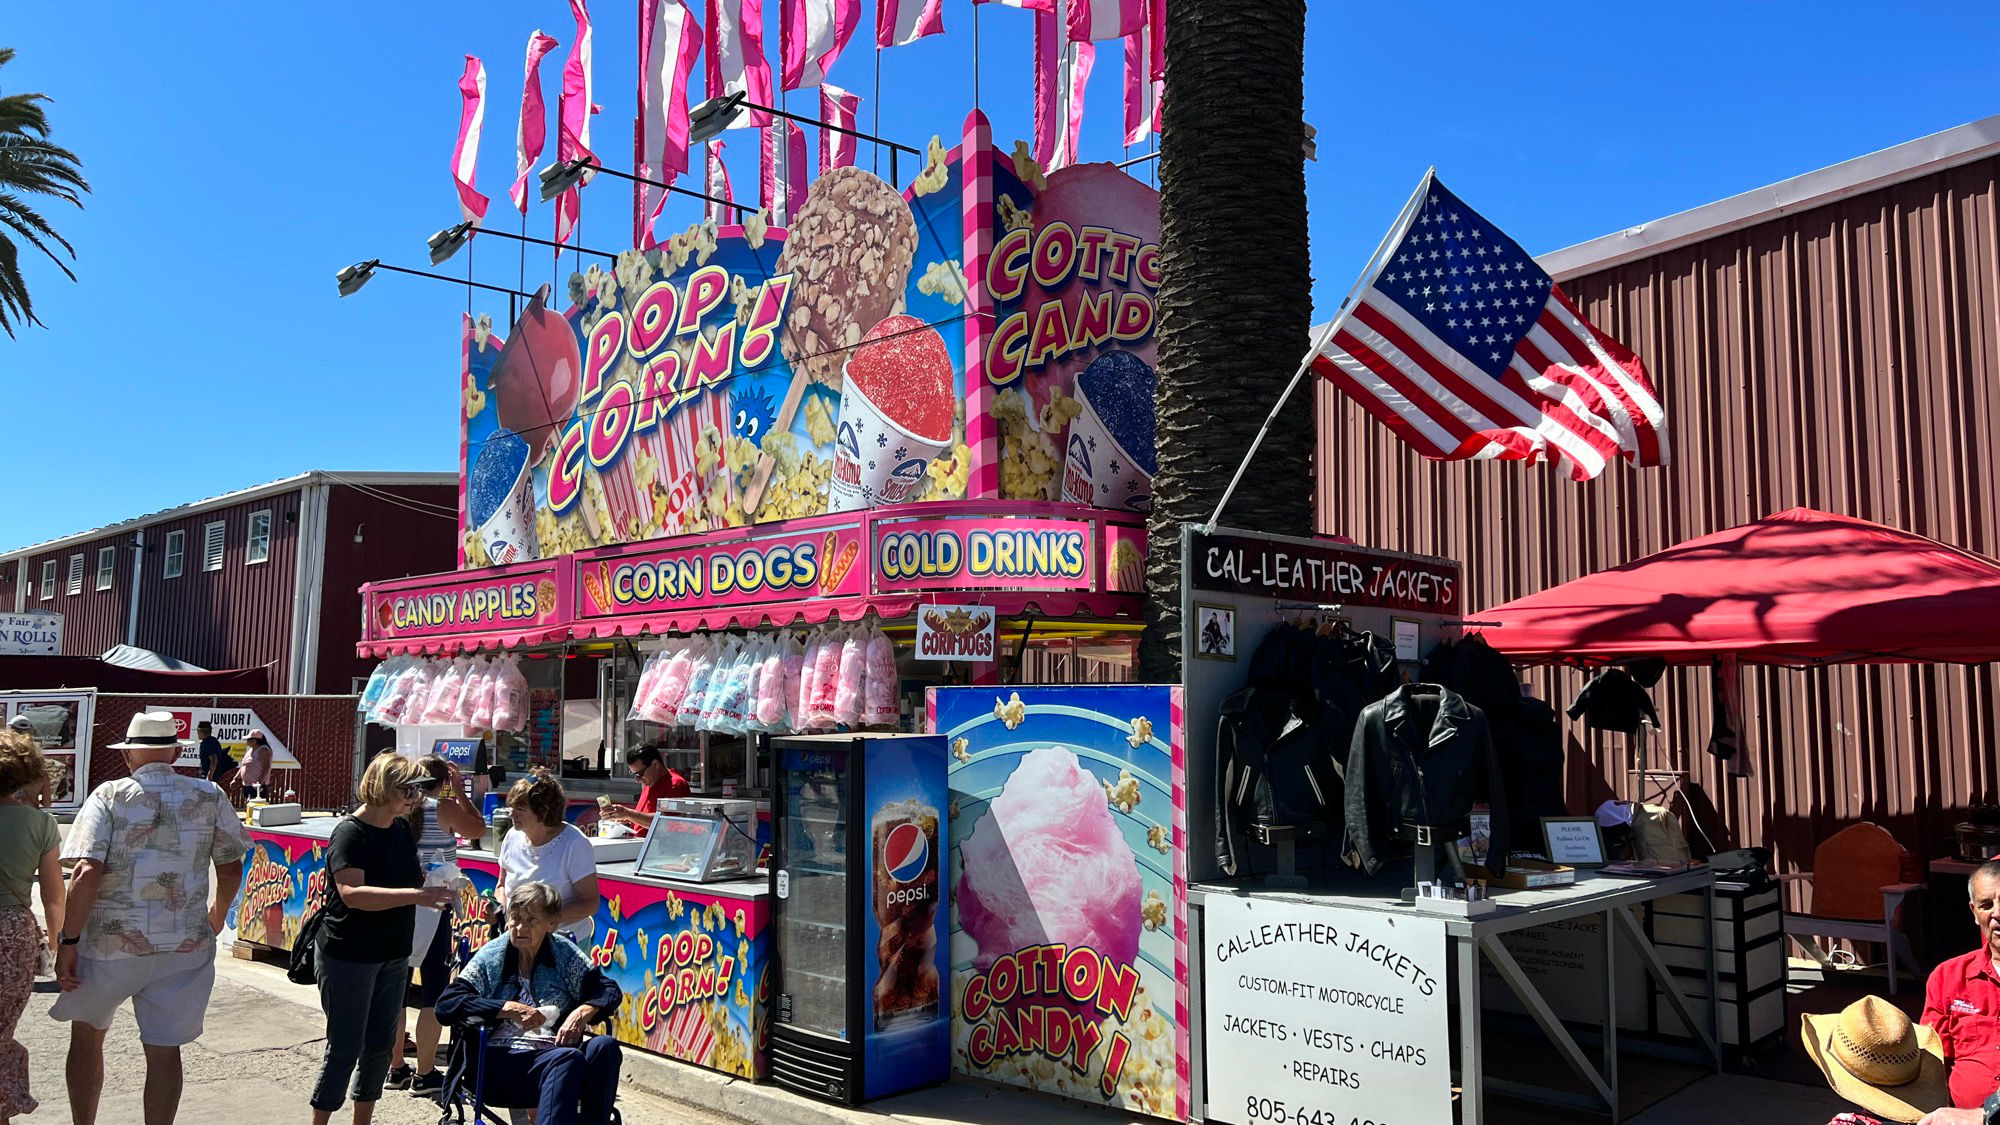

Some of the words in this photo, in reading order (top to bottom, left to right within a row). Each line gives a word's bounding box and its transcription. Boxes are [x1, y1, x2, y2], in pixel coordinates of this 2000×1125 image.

[986, 222, 1161, 301] COTTO
[581, 264, 730, 408] POP
[985, 290, 1159, 385] CAND
[612, 555, 704, 604] CORN
[709, 543, 817, 595] DOGS
[880, 530, 962, 581] COLD
[967, 529, 1086, 580] DRINKS
[1206, 547, 1365, 593] CAL-LEATHER
[1369, 566, 1453, 604] JACKETS
[9, 617, 31, 626] Fair
[393, 592, 458, 629] CANDY
[459, 583, 536, 624] APPLES
[13, 630, 57, 645] ROLLS
[921, 631, 956, 656] CORN
[958, 631, 992, 656] DOGS
[210, 713, 245, 725] JUNIOR
[449, 745, 471, 758] pepsi
[810, 755, 831, 766] pepsi
[246, 861, 288, 896] CANDY
[307, 868, 328, 903] PO
[887, 883, 926, 909] pepsi
[1568, 920, 1600, 934] JACKE
[656, 930, 713, 977] POP
[1217, 922, 1338, 963] CAL-LEATHER
[1345, 932, 1438, 996] JACKETS
[641, 955, 735, 1031] CORN!
[963, 944, 1140, 1023] COTTON
[1238, 975, 1315, 999] CUSTOM-FIT
[1318, 987, 1404, 1014] MOTORCYCLE
[1223, 1014, 1287, 1041] JACKETS
[1303, 1028, 1354, 1053] VESTS
[1371, 1041, 1426, 1066] CHAPS
[1293, 1060, 1360, 1090] REPAIRS
